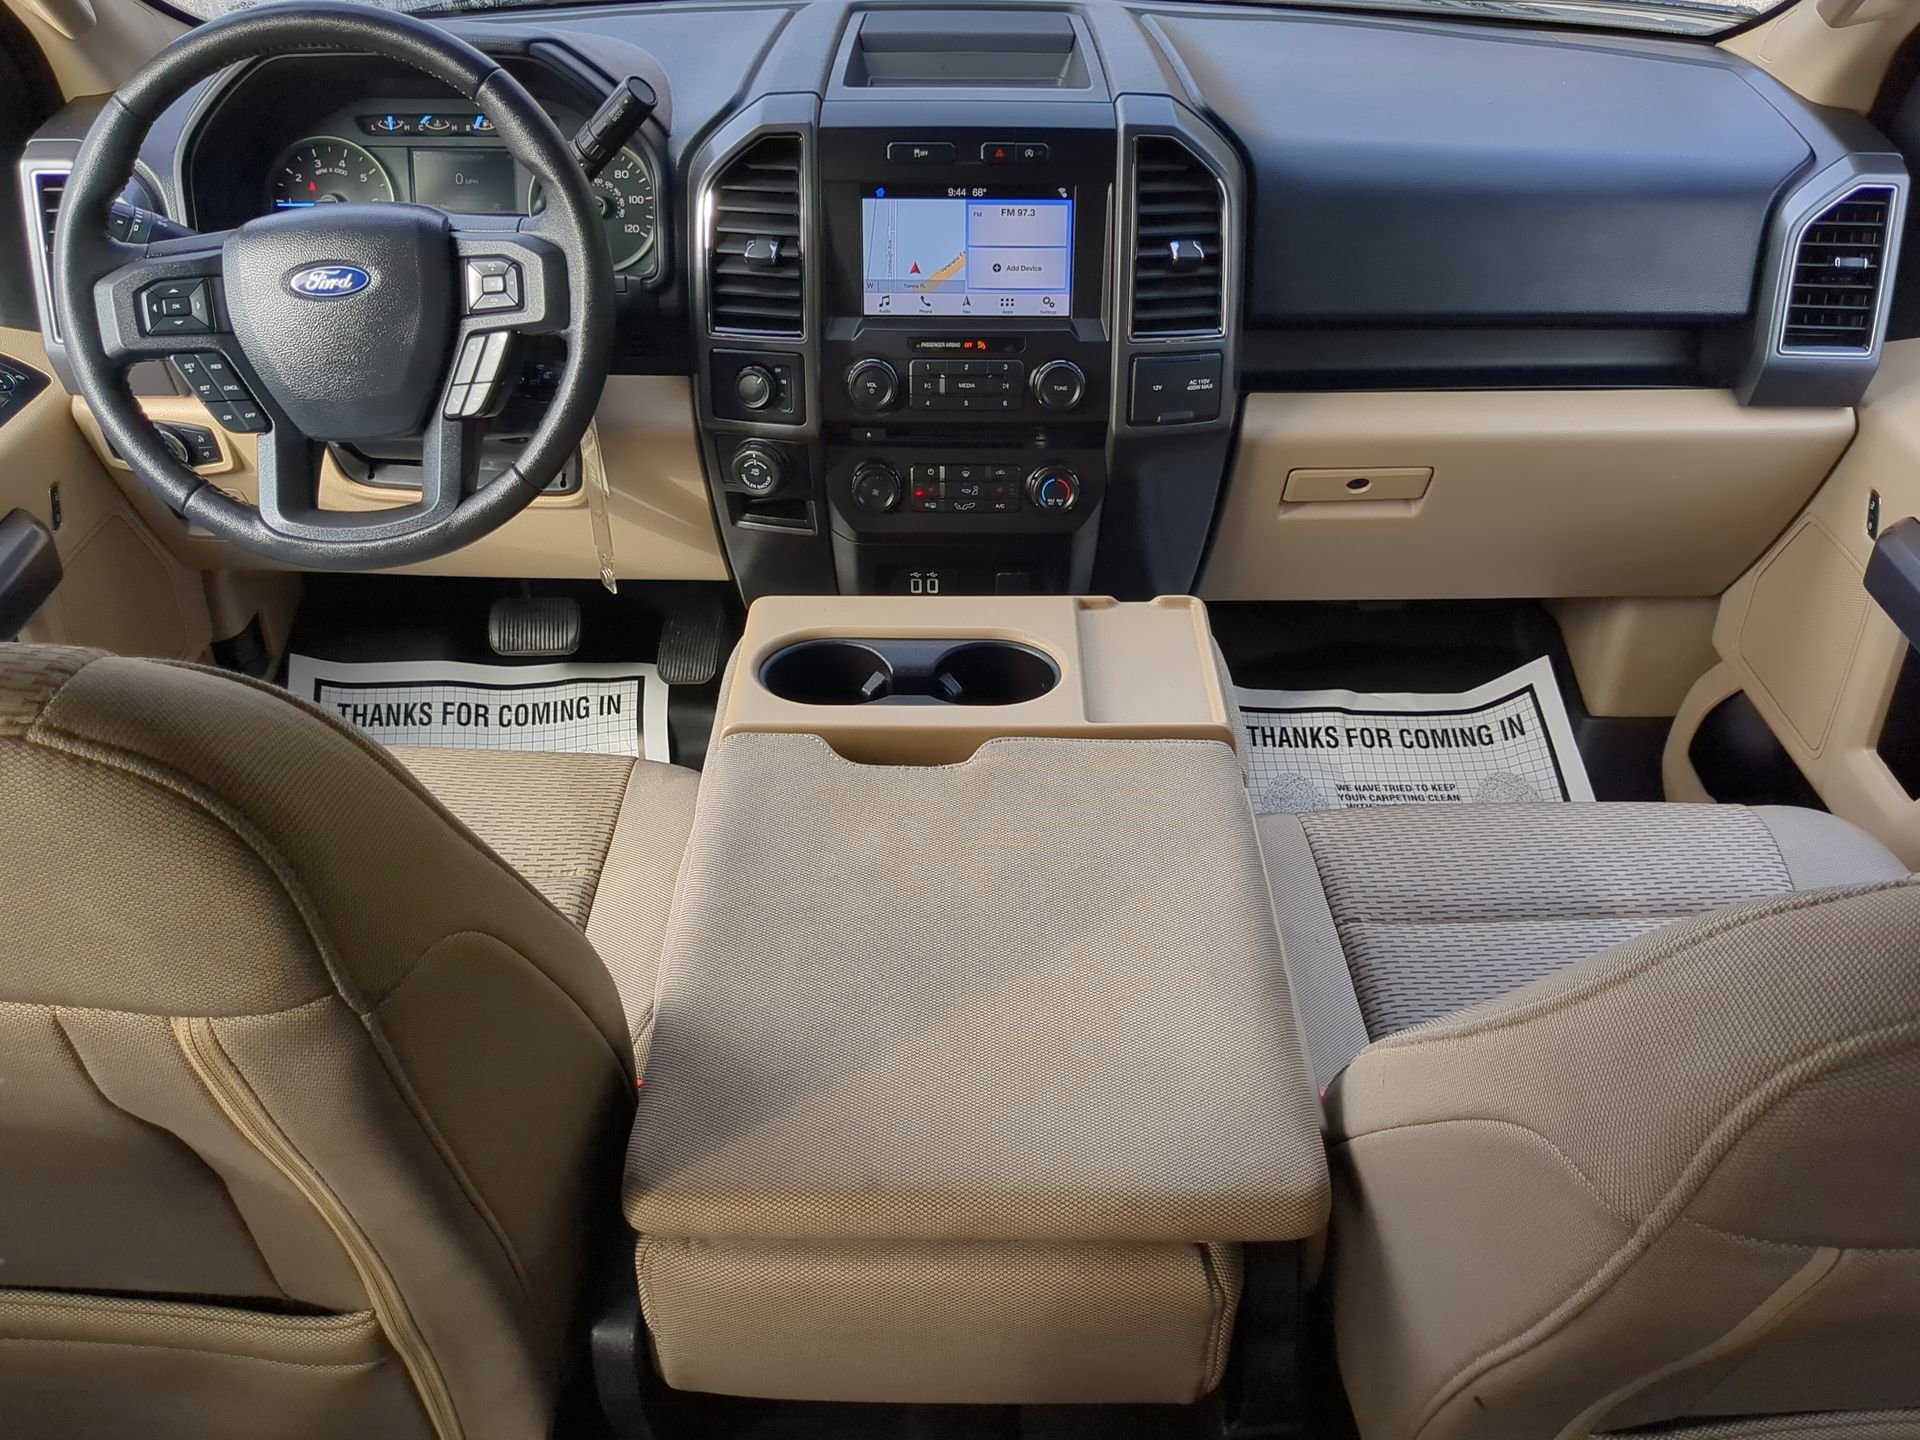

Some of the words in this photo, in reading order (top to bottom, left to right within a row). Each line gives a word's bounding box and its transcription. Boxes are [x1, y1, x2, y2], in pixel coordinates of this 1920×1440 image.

[314, 160, 322, 168] 3
[315, 168, 327, 176] RPM
[614, 170, 629, 179] 80
[295, 174, 302, 182] 2
[360, 174, 368, 182] 5
[455, 173, 464, 185] 0
[947, 188, 967, 197] 9:44
[628, 195, 644, 204] 100
[1001, 208, 1015, 217] FM
[1017, 208, 1036, 217] 97.3
[624, 224, 639, 233] 120
[305, 270, 352, 291] Ford
[337, 702, 433, 728] THANKS
[442, 701, 489, 728] FOR
[499, 695, 591, 728] COMING
[599, 694, 622, 716] IN
[1246, 725, 1340, 749] THANKS
[1344, 727, 1393, 749] FOR
[1399, 724, 1494, 750] COMING
[1500, 714, 1527, 742] IN
[1336, 783, 1352, 792] WE
[1354, 784, 1380, 792] HAVE
[1382, 784, 1412, 792] TRIED
[1415, 784, 1428, 792] TO
[1431, 783, 1456, 791] KEEP
[1427, 793, 1460, 801] CLEAN
